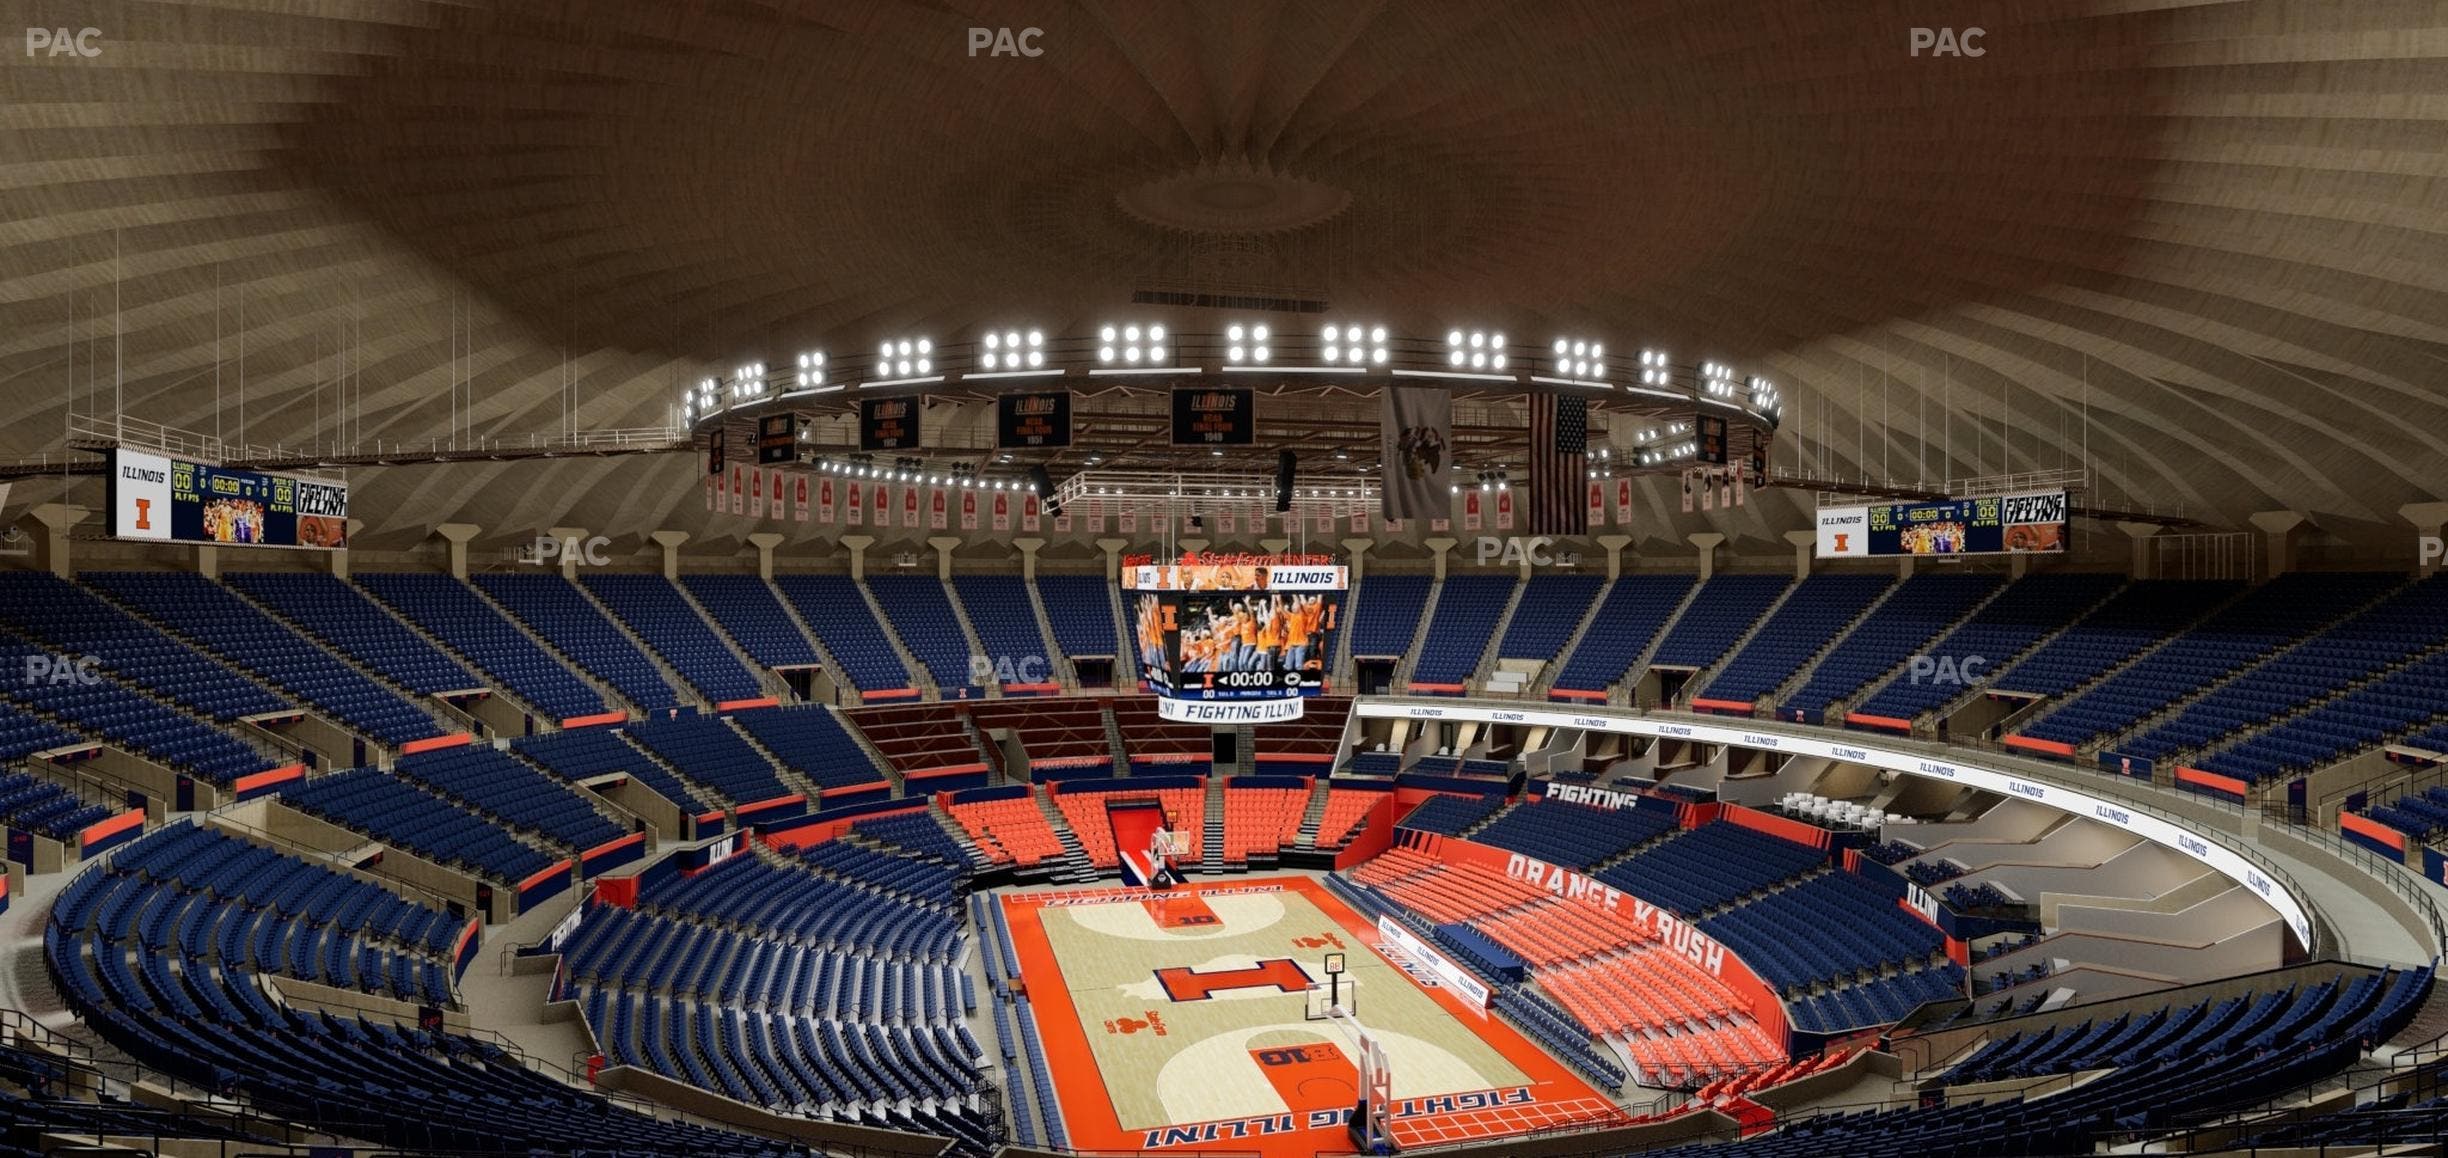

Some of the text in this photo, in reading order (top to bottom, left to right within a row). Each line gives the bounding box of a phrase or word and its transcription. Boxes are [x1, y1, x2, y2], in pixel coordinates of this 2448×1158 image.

[1015, 397, 1056, 414] ILLINOIS
[1191, 393, 1237, 408] ILLINOIS
[873, 402, 908, 418] ILLINOIS
[122, 465, 165, 484] ILLINOIS
[174, 472, 191, 489] 00
[213, 478, 239, 493] 00:00
[301, 484, 346, 502] FIGHTING
[276, 488, 290, 501] 00
[2005, 494, 2063, 511] FIGHTING
[300, 499, 345, 516] ILLINI
[1911, 509, 1938, 520] 00:00
[1979, 505, 1996, 517] 00
[2004, 507, 2064, 524] ILLINI
[1821, 515, 1863, 525] ILLINOIS
[1872, 513, 1887, 524] 00
[1272, 572, 1334, 585] ILLINOIS
[1230, 671, 1273, 687] 00:00
[1203, 689, 1216, 699] 00
[1286, 687, 1299, 697] 00
[1185, 701, 1299, 720] FIGHTING ILLINI
[1410, 708, 1443, 716] ILLINOIS
[1492, 712, 1524, 721] ILLINOIS
[1574, 717, 1607, 727] ILLINOIS
[1658, 725, 1692, 736] ILLINOIS
[1744, 734, 1778, 747] ILLINOIS
[1832, 747, 1866, 760] ILLINOIS
[1919, 761, 1955, 777] ILLINOIS
[1546, 782, 1638, 810] FIGHTING
[2009, 781, 2045, 798] ILLINOIS
[2096, 805, 2130, 825] ILLINOIS
[709, 836, 734, 865] ILLINI
[2178, 834, 2208, 857] ILLINOIS
[1199, 884, 1284, 897] ILLINI
[2247, 870, 2271, 897] ILLINOIS
[1907, 881, 1939, 925] ILLINI
[1507, 854, 1724, 977] ORANGE KRUSH
[1382, 920, 1402, 939] ILLINOIS
[1417, 945, 1440, 967] ILLINOIS
[1458, 975, 1485, 1000] ILLINOIS
[1143, 1088, 1534, 1150] FIGHTG ILLINI
